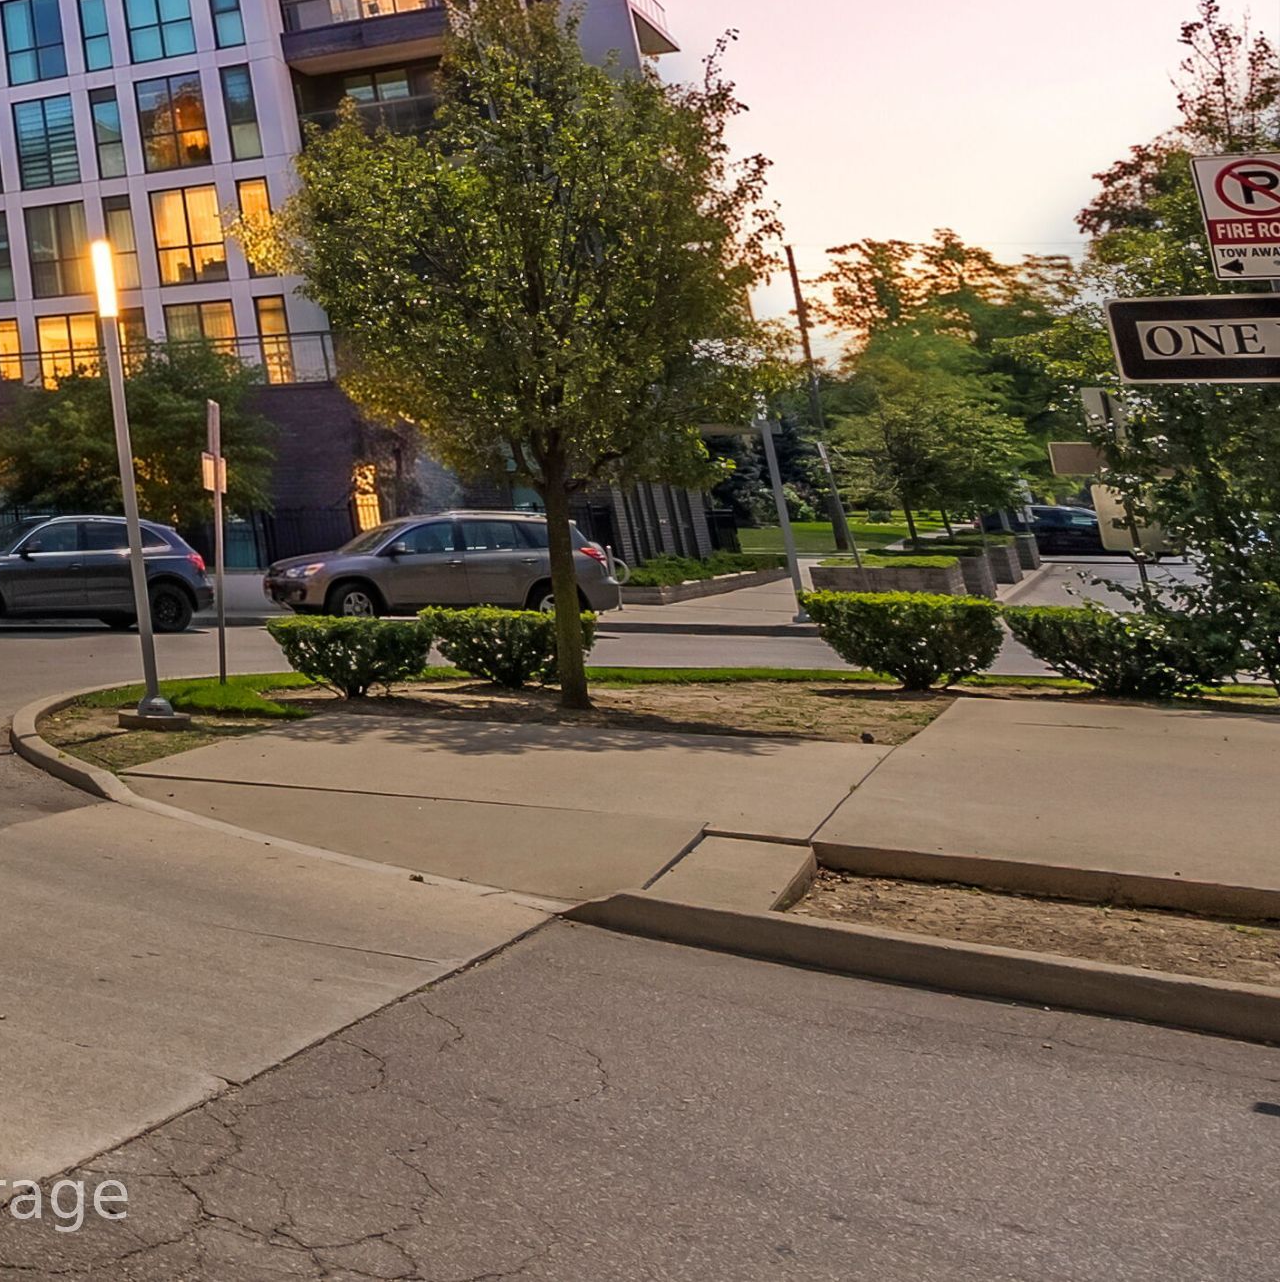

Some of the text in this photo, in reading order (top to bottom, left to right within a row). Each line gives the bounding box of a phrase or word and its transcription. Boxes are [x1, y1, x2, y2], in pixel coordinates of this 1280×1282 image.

[1215, 222, 1255, 239] FIRE
[1218, 247, 1280, 258] TOW AWA
[1145, 323, 1266, 357] ONE
